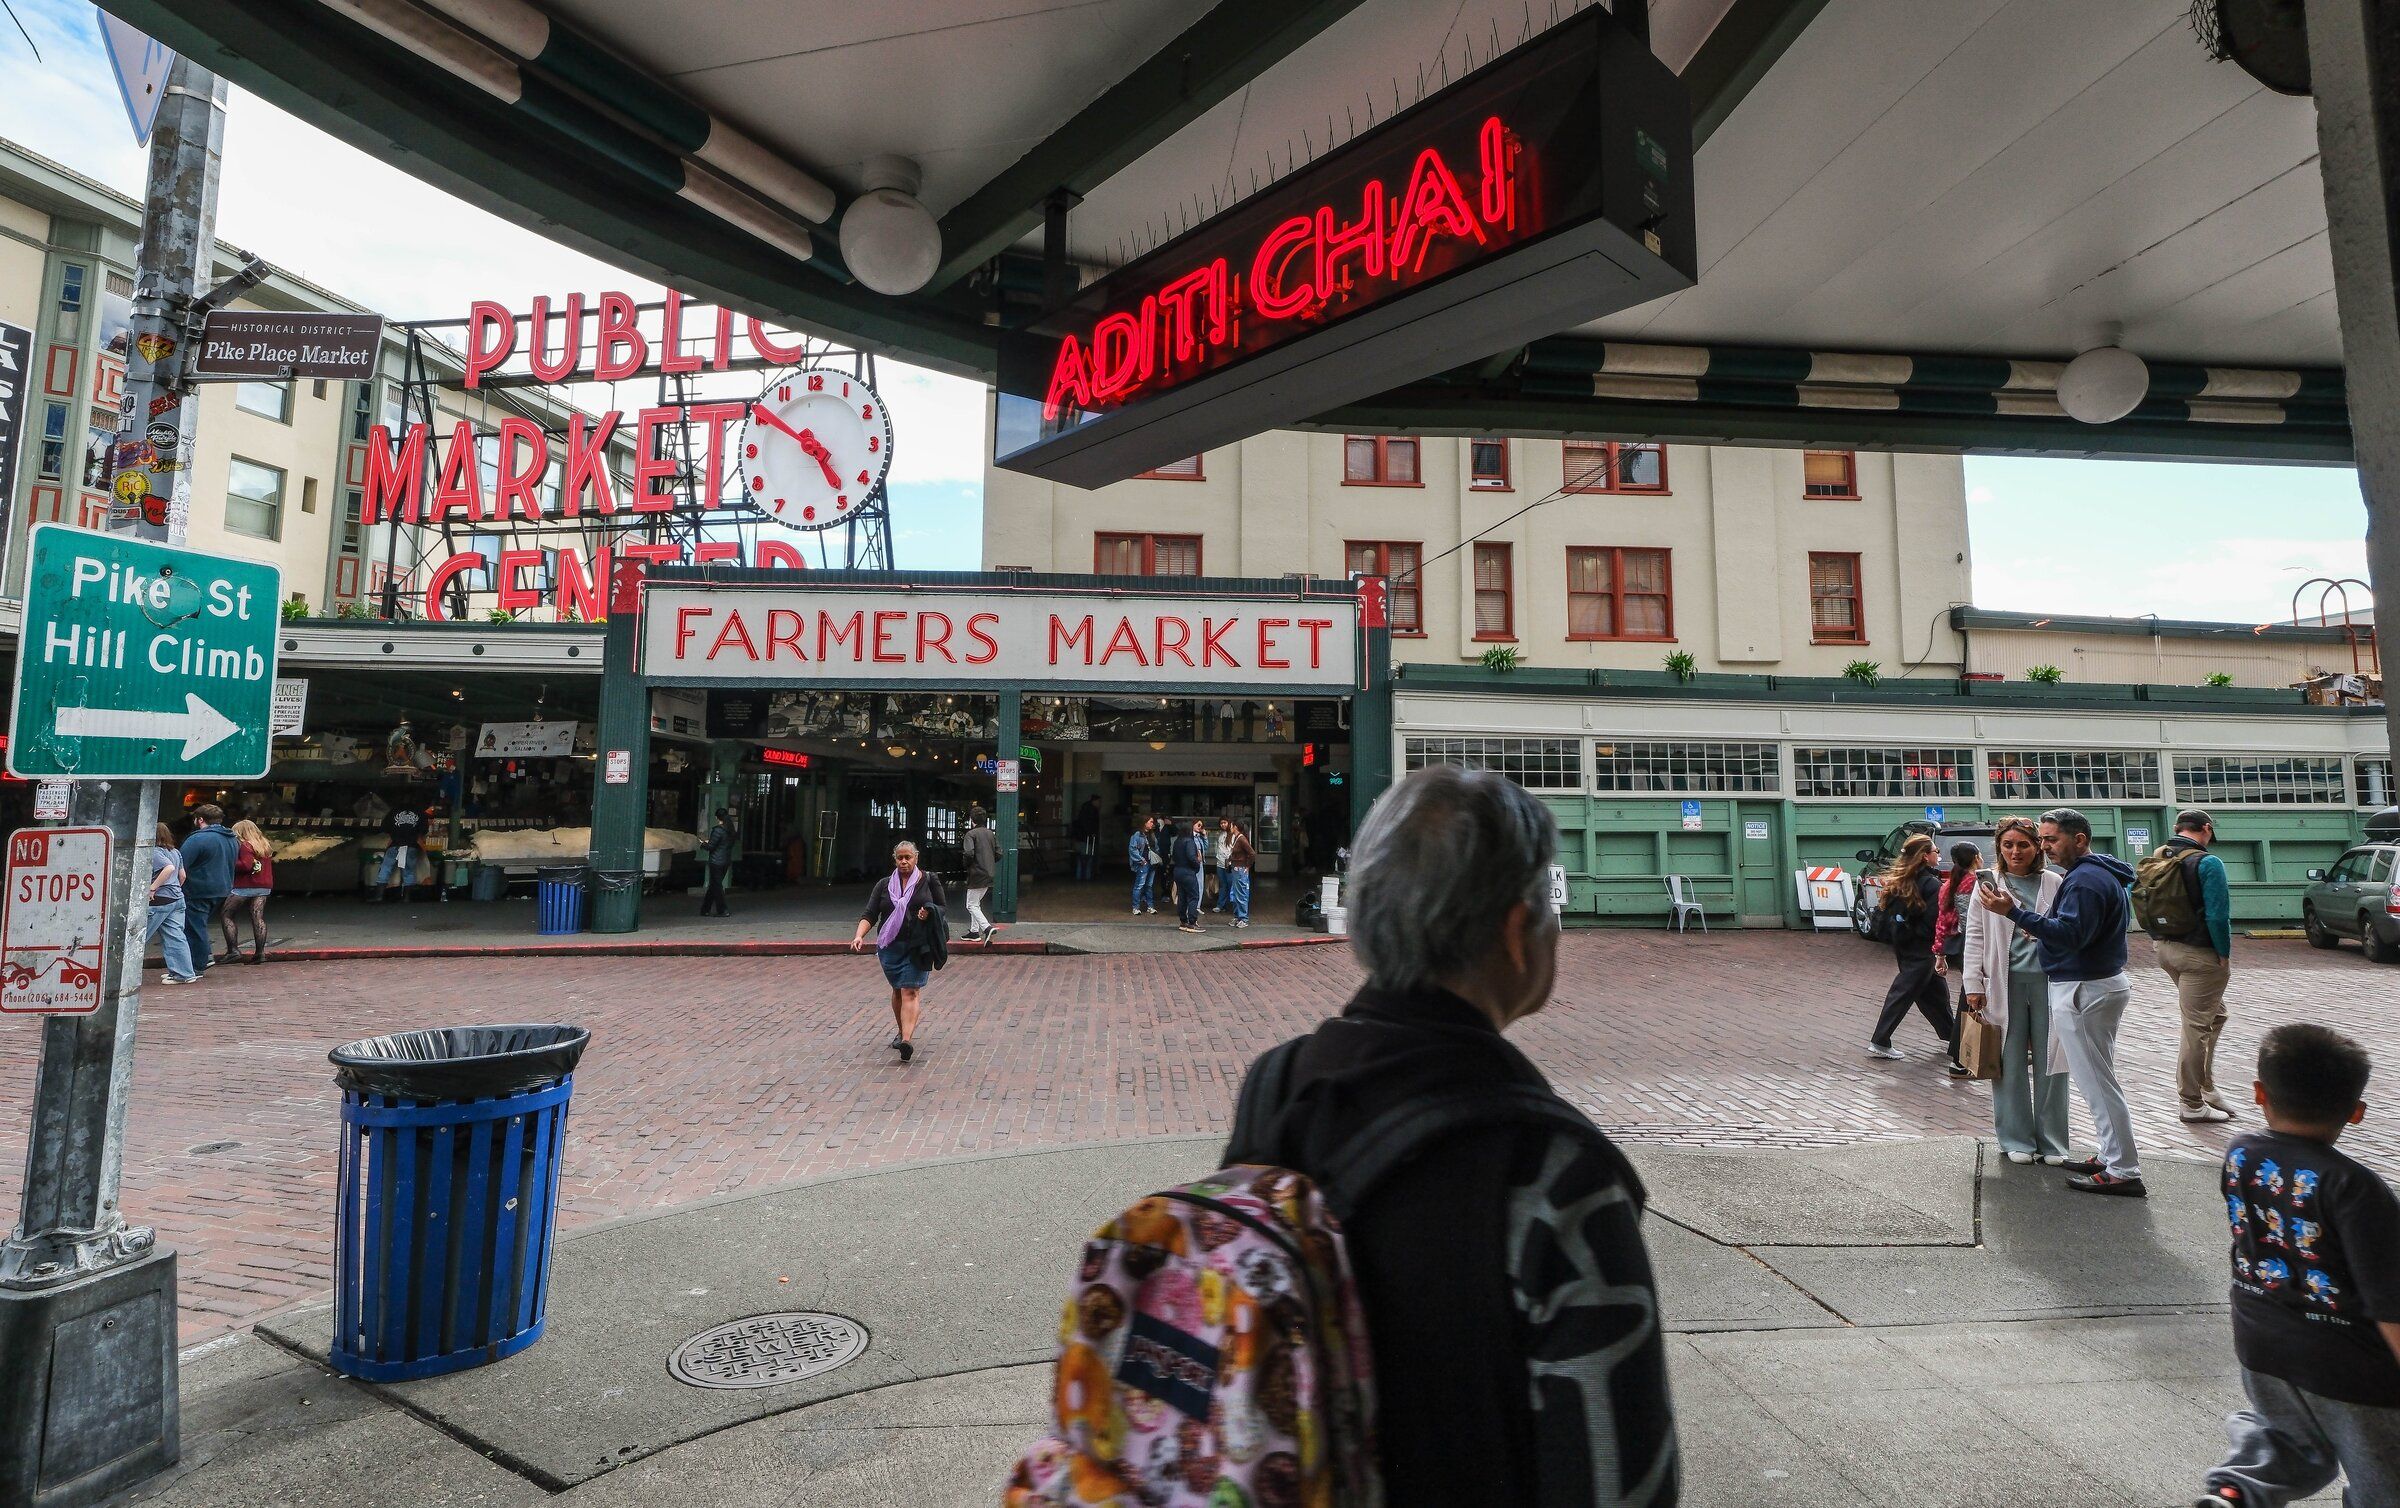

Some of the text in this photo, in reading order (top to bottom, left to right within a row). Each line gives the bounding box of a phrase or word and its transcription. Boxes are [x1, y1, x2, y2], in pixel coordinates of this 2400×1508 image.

[1043, 117, 1508, 421] ADITI CHAI
[230, 324, 353, 335] HISTORICAL DISTRICT
[465, 288, 803, 389] PUBLIC
[205, 341, 369, 365] Pike Place Market
[808, 375, 824, 391] 12
[842, 382, 849, 397] 1
[778, 386, 791, 402] 11
[862, 404, 873, 419] 2
[746, 443, 758, 459] 9
[868, 436, 879, 452] 3
[362, 404, 747, 525] MARKET
[752, 475, 764, 491] 8
[857, 469, 870, 485] 4
[774, 498, 786, 513] 7
[836, 495, 848, 511] 5
[803, 506, 815, 521] 6
[72, 556, 252, 621] Pike St
[675, 607, 1333, 669] FARMERS MARKET
[44, 621, 265, 681] Hill Climb
[16, 838, 43, 861] NO
[19, 873, 95, 903] STOPS
[4, 993, 26, 1003] Phone
[54, 992, 94, 1002] 684-5444
[703, 1332, 838, 1363] SEWER
